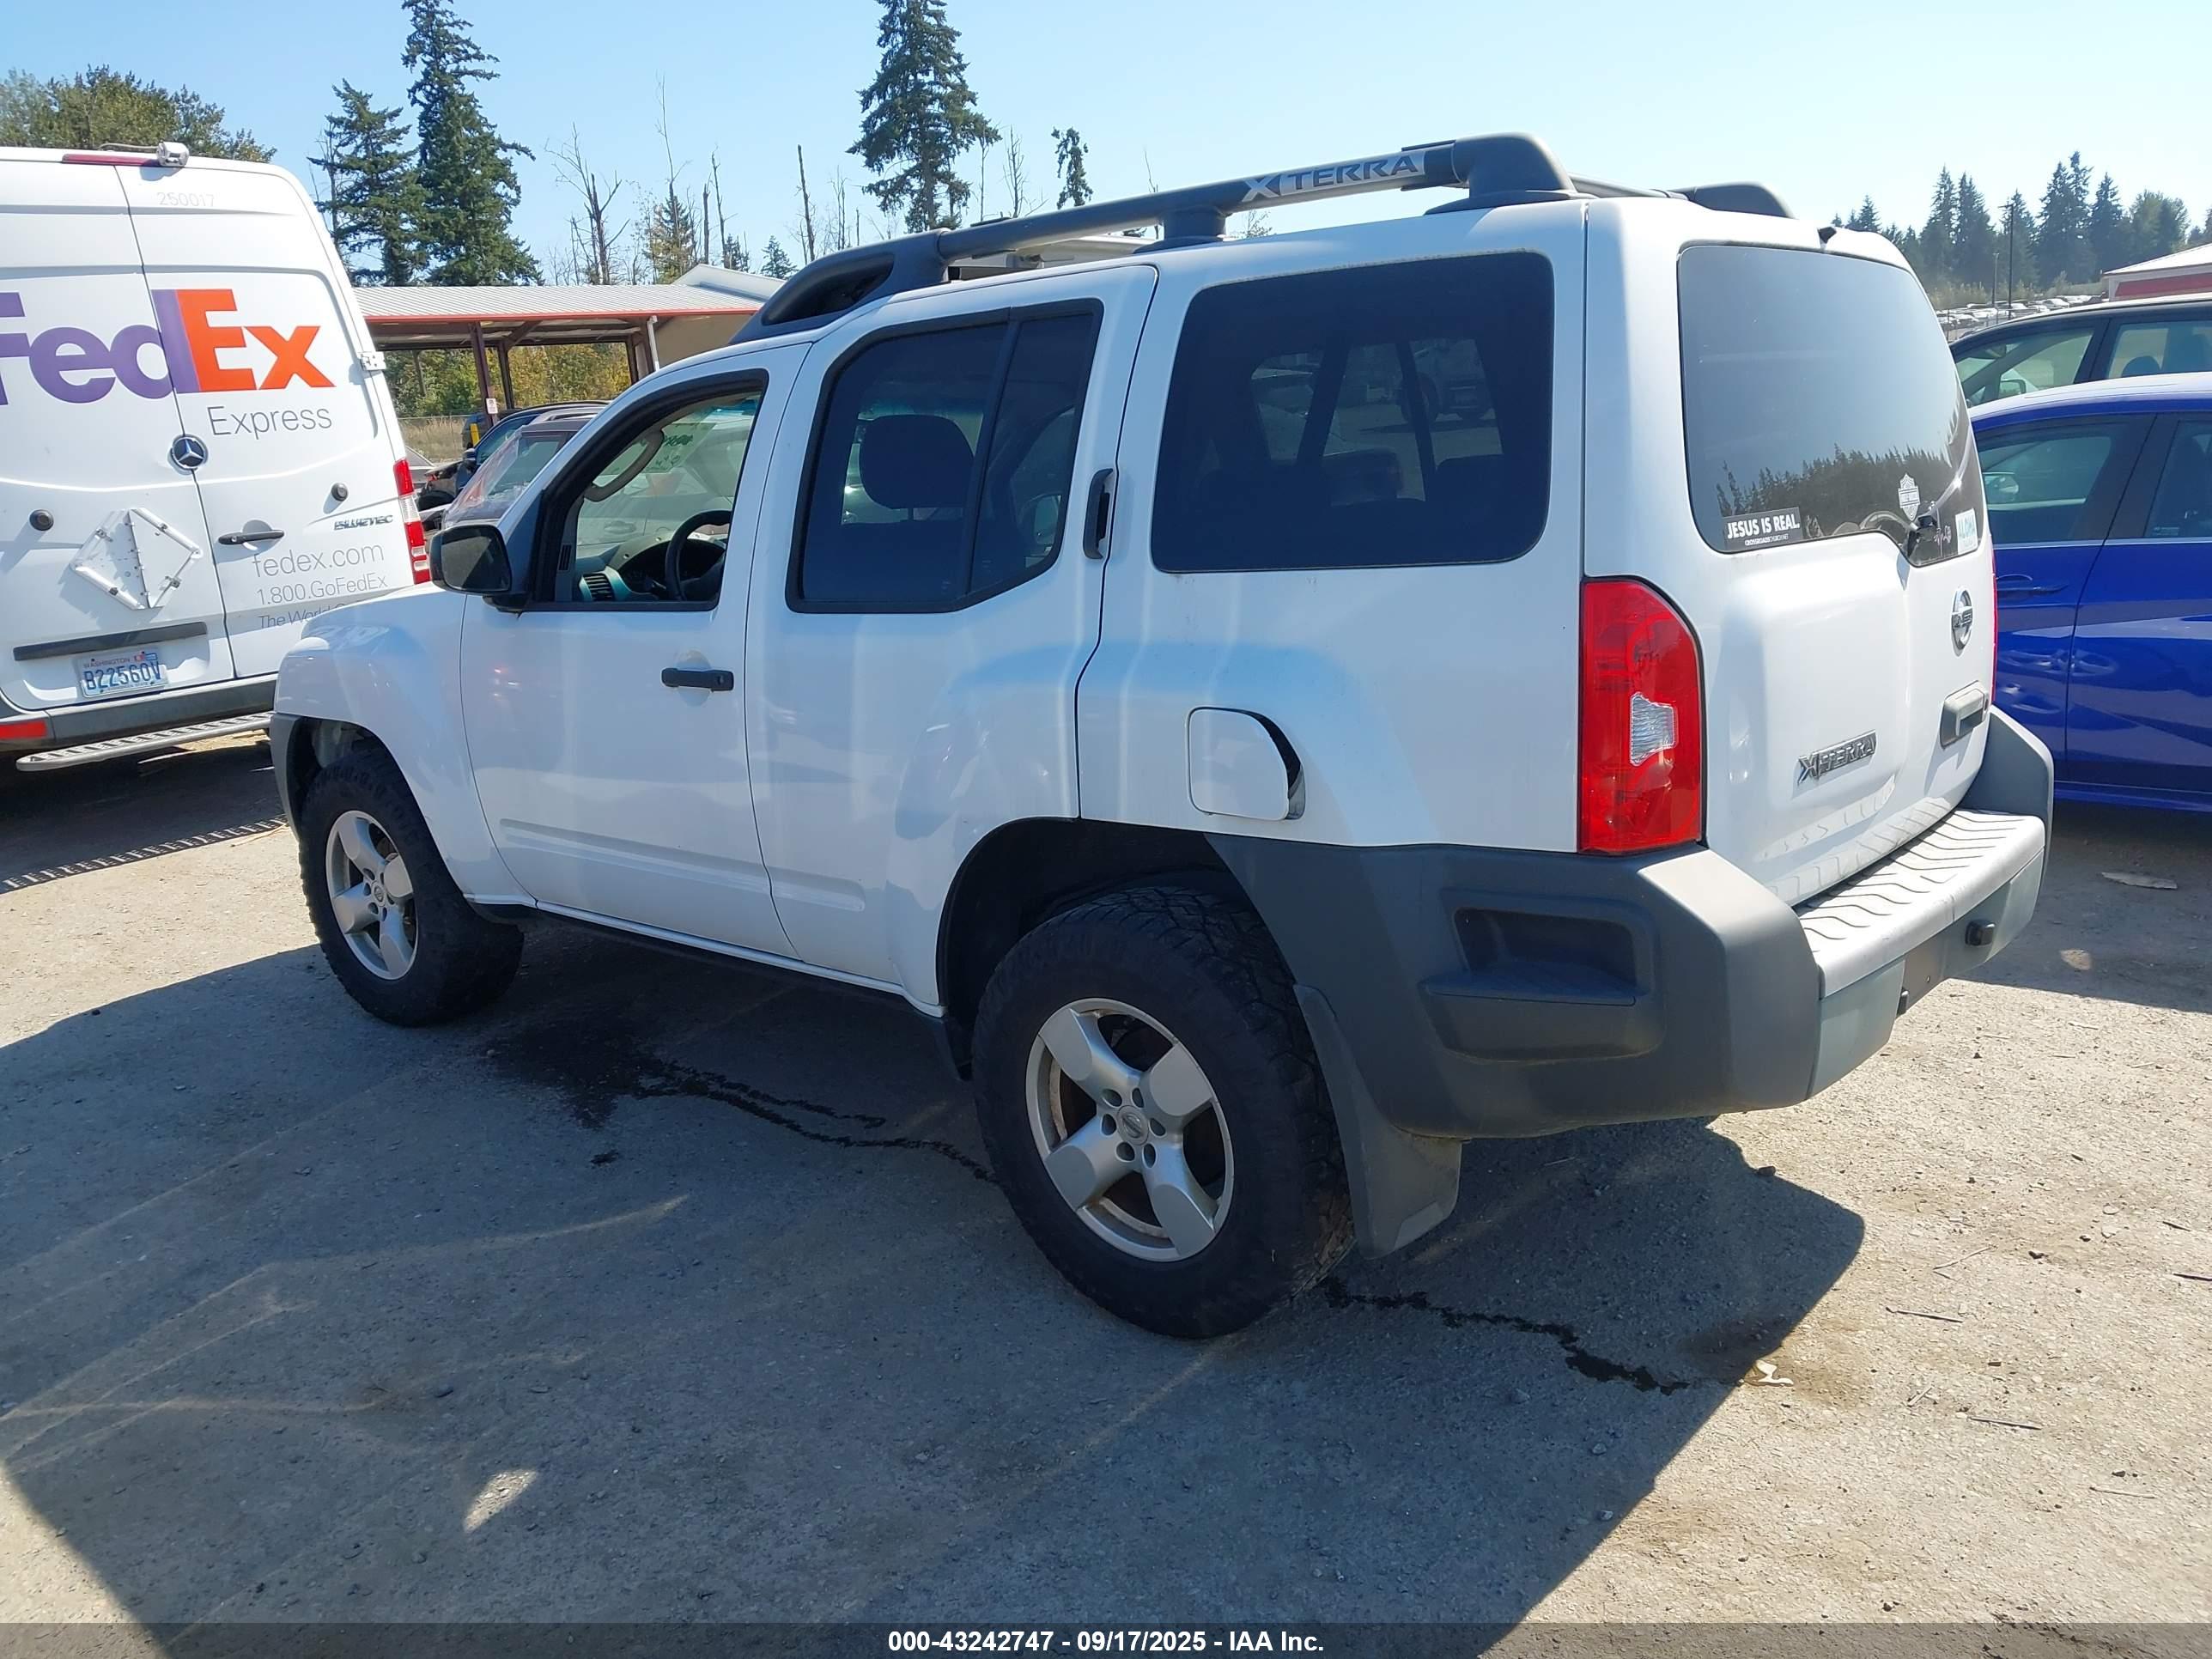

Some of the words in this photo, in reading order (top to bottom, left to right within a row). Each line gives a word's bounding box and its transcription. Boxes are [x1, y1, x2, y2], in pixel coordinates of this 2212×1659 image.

[1241, 155, 1419, 203] XTERRA
[156, 191, 214, 207] 250017
[208, 406, 332, 440] Express
[1728, 519, 1759, 539] JESUS
[1760, 517, 1772, 534] IS
[252, 544, 385, 577] fedex.com
[257, 572, 388, 605] 1.800.GoFedEx
[258, 615, 286, 629] The
[288, 605, 331, 625] Worl
